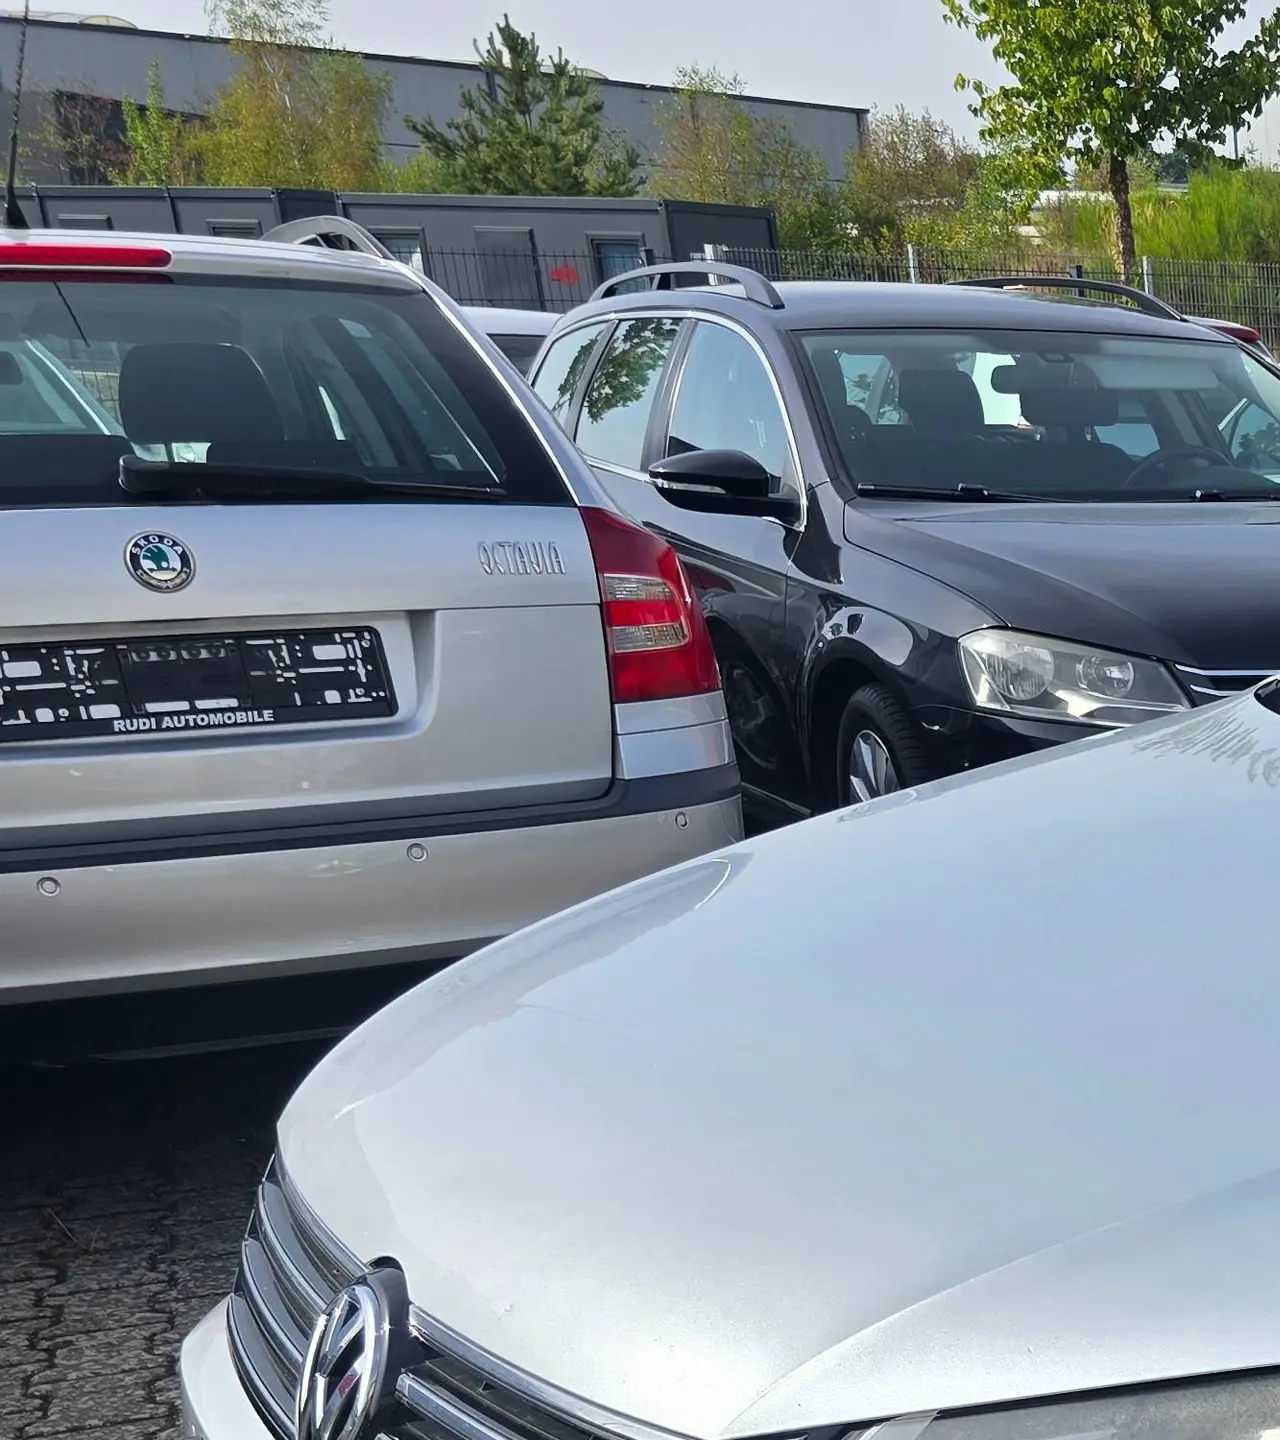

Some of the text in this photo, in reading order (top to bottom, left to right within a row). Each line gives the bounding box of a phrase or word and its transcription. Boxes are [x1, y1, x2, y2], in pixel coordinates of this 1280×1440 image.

[477, 540, 567, 575] OCTAVIA
[113, 709, 275, 732] RUDI AUTOMOBILE
